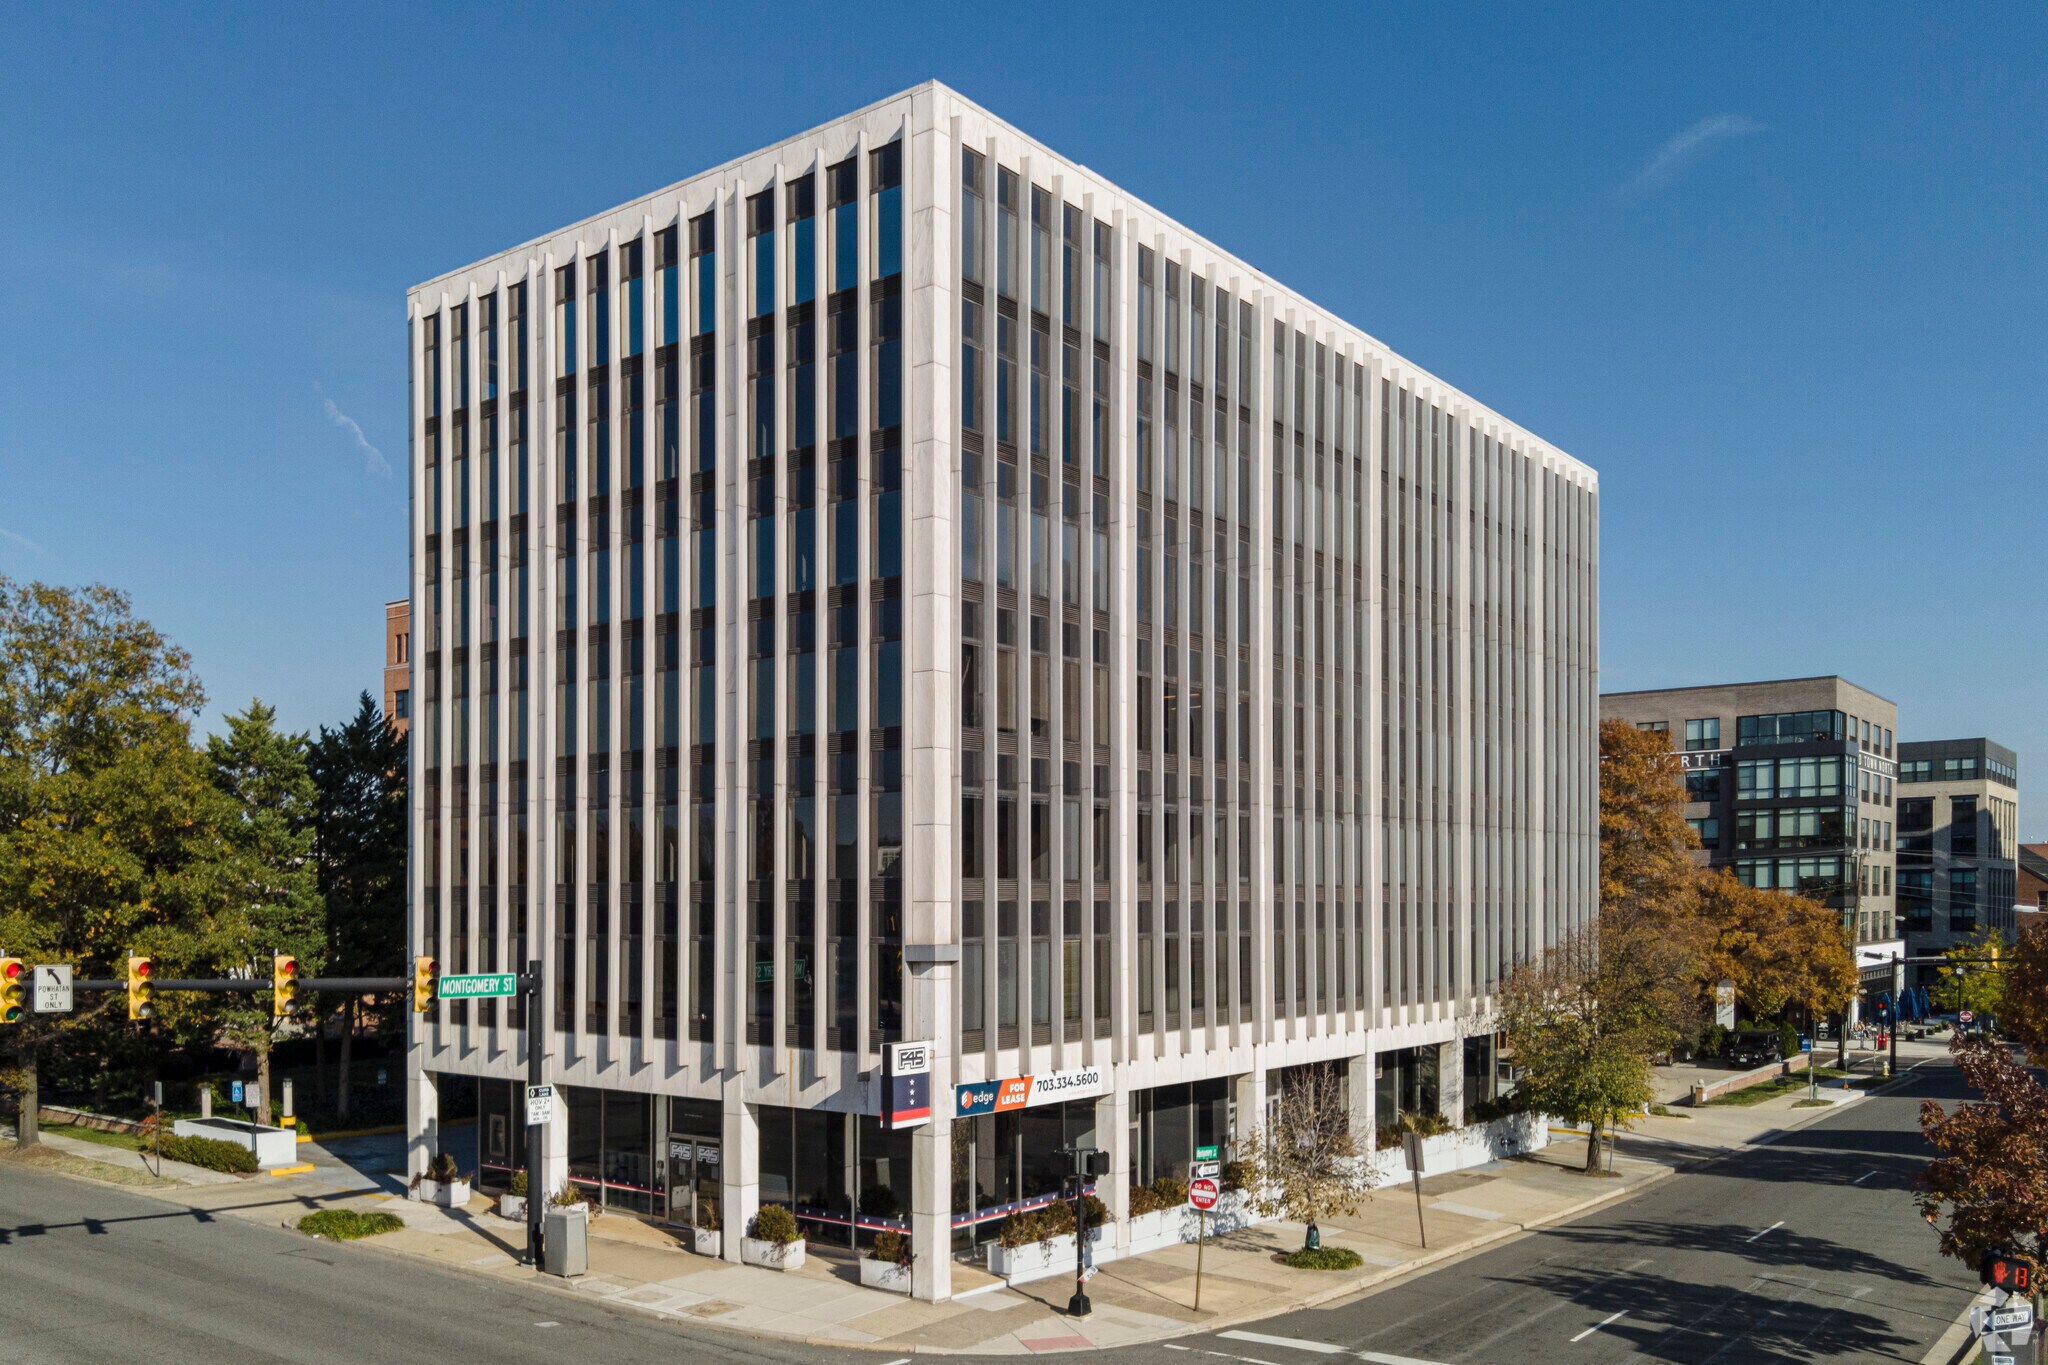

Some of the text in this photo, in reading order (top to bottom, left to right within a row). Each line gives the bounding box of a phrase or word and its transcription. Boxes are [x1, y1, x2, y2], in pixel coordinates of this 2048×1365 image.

[1648, 753, 1720, 768] NRTH
[442, 977, 513, 994] MONTGOMERY ST
[45, 1001, 63, 1009] ONLY
[899, 1047, 925, 1069] F45
[1009, 1083, 1025, 1093] FOR
[1036, 1072, 1099, 1092] 703.334.5600
[973, 1091, 994, 1105] edge
[1001, 1093, 1026, 1105] LEASE
[670, 1142, 692, 1160] F45
[697, 1145, 719, 1164] F45
[2014, 1267, 2028, 1288] 13
[1996, 1314, 2026, 1325] ONE WAY
